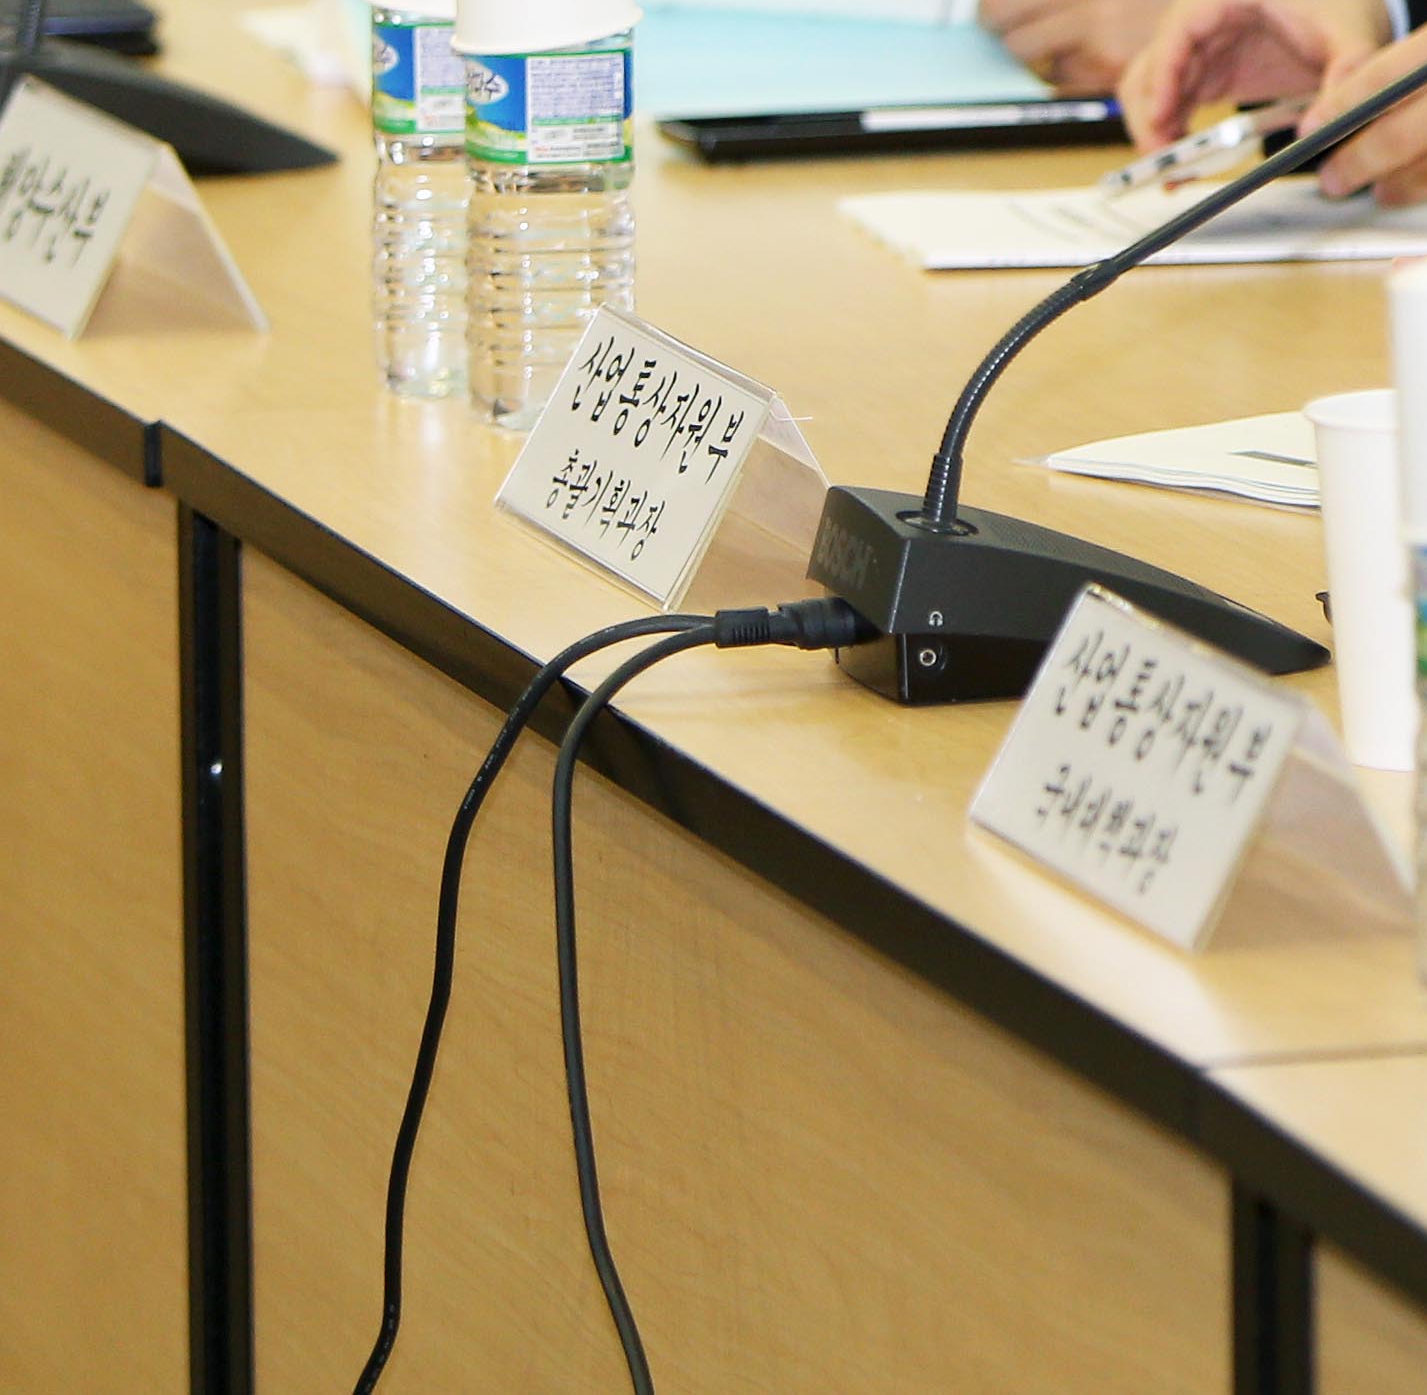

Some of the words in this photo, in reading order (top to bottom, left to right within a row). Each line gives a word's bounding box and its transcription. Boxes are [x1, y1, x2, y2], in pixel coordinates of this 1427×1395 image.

[571, 335, 744, 484] 산업통상자원부
[546, 448, 666, 561] 총괄기획과장
[1054, 630, 1272, 805] 산업통상자원부
